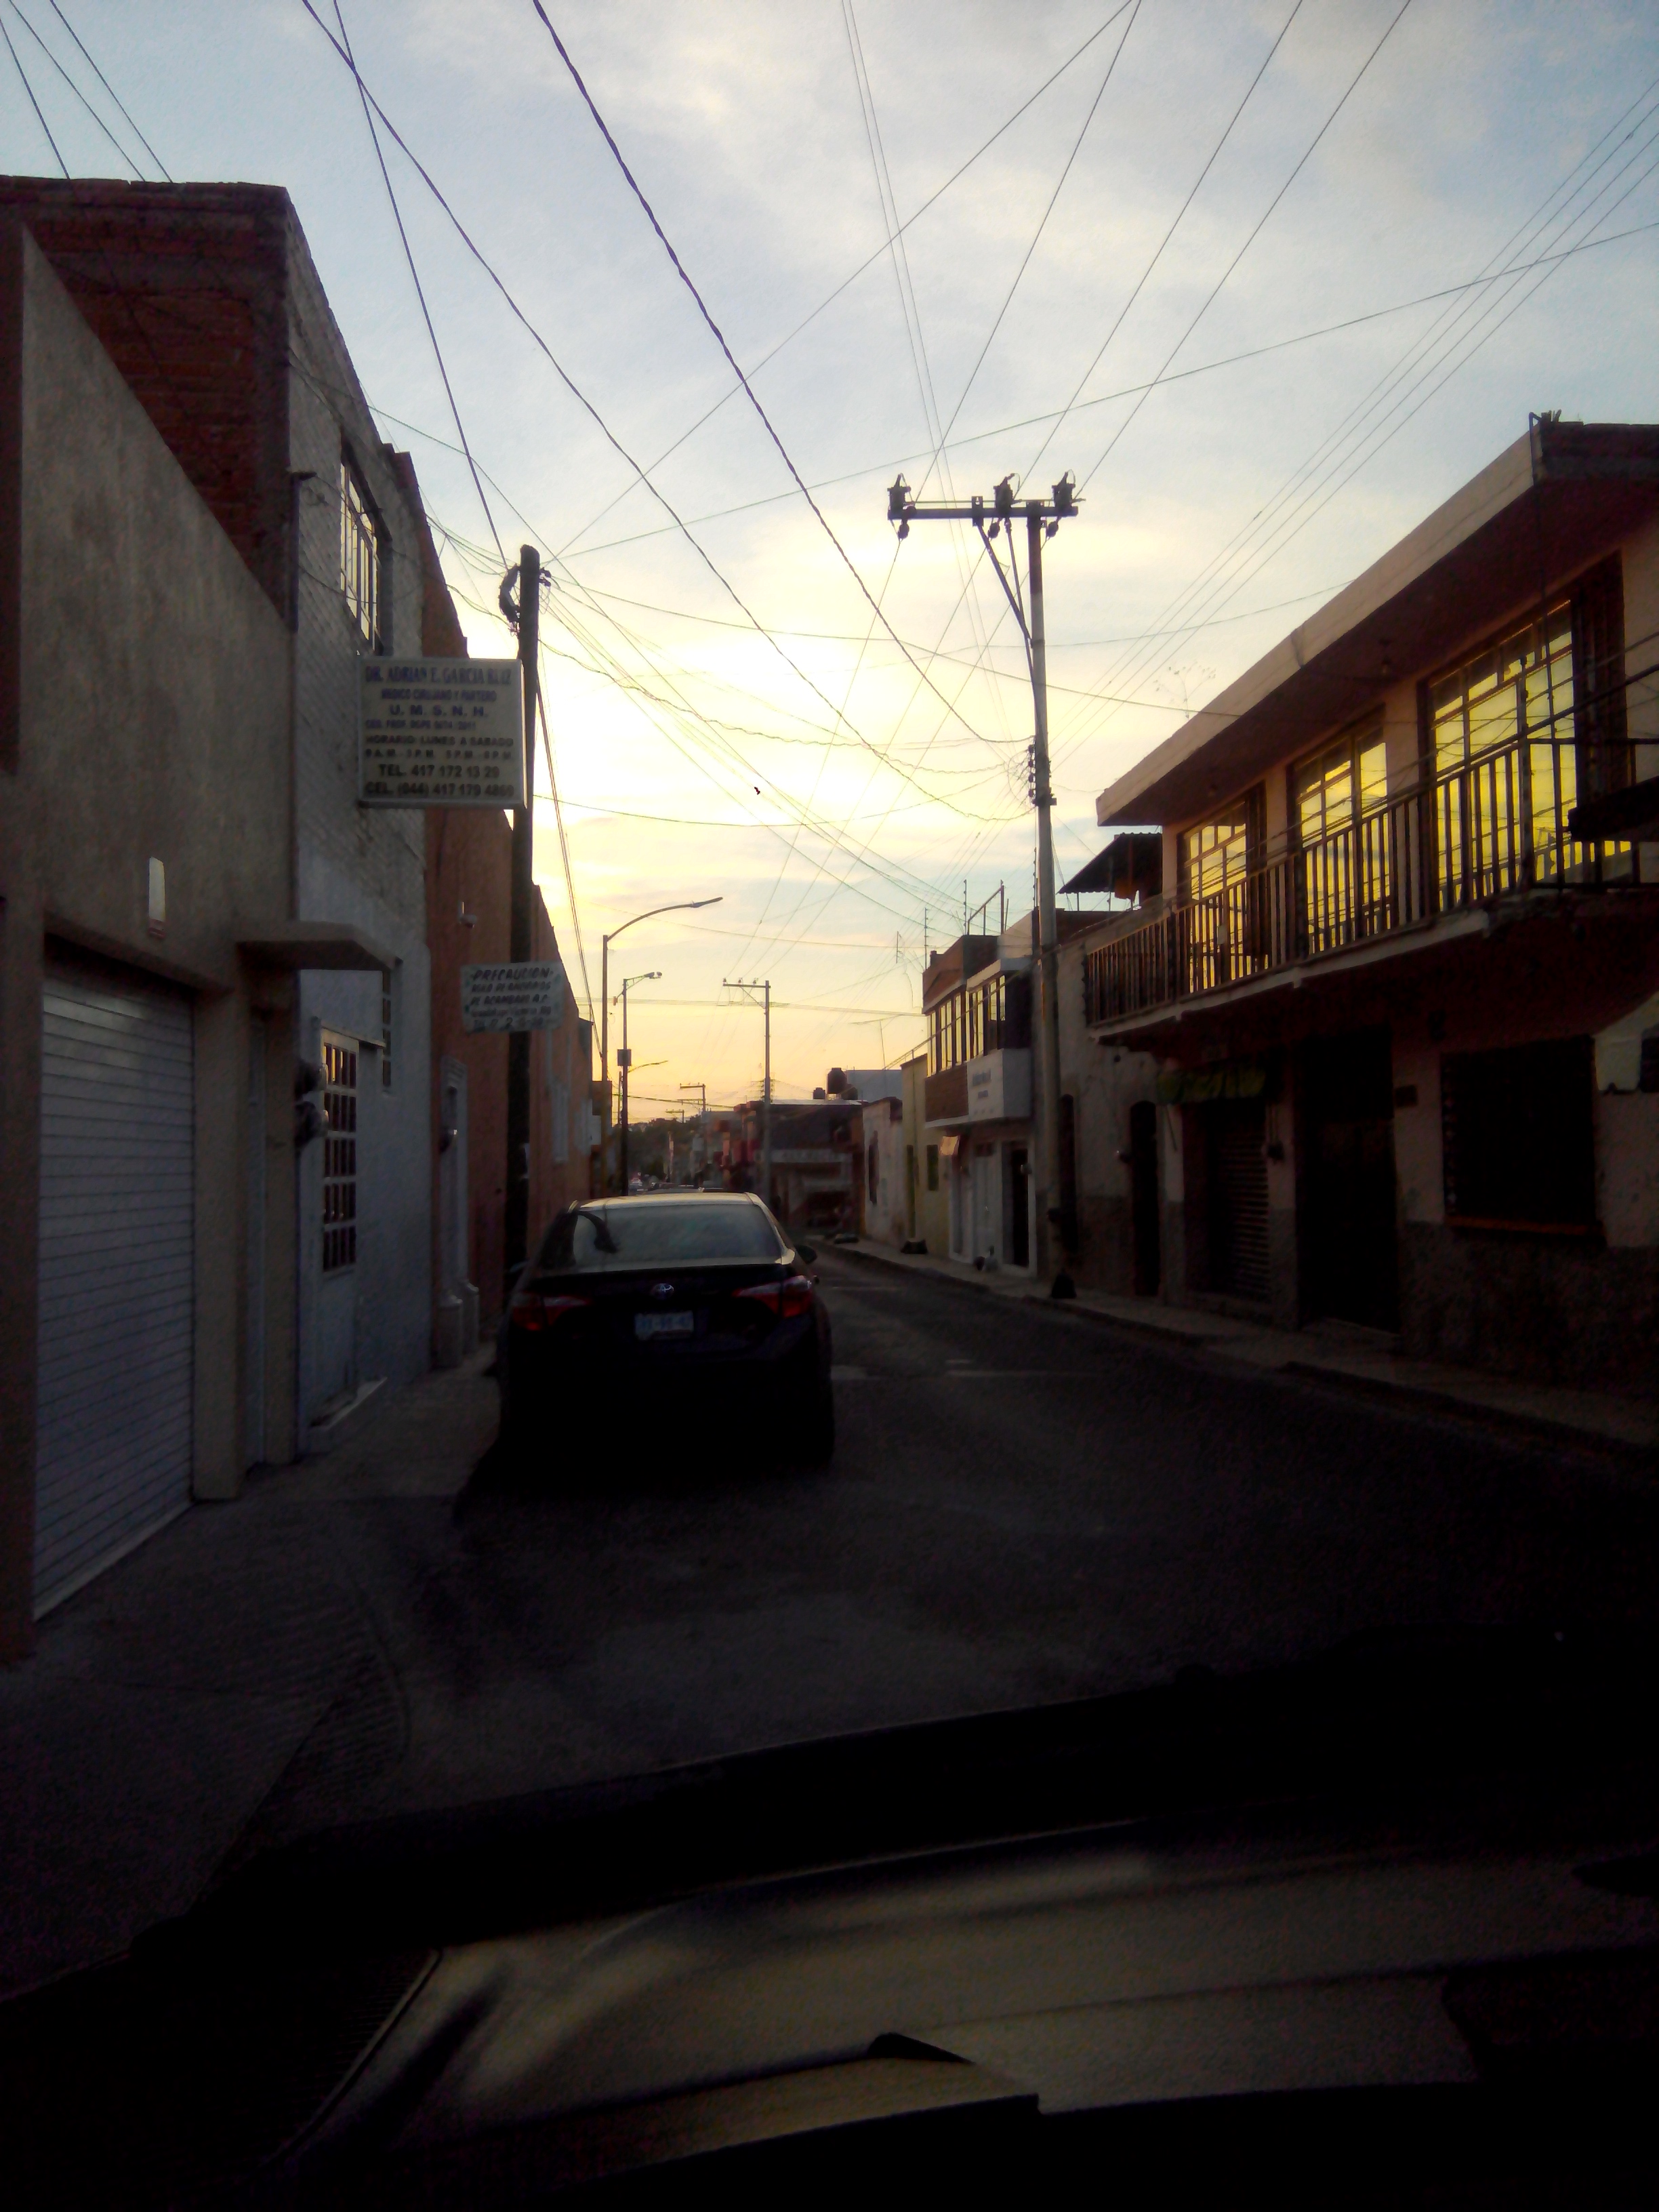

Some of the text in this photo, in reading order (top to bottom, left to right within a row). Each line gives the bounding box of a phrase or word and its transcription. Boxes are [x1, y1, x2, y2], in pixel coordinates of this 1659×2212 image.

[461, 737, 467, 745] A
[411, 764, 435, 777] 417
[439, 765, 462, 777] 172
[433, 783, 456, 796] 417
